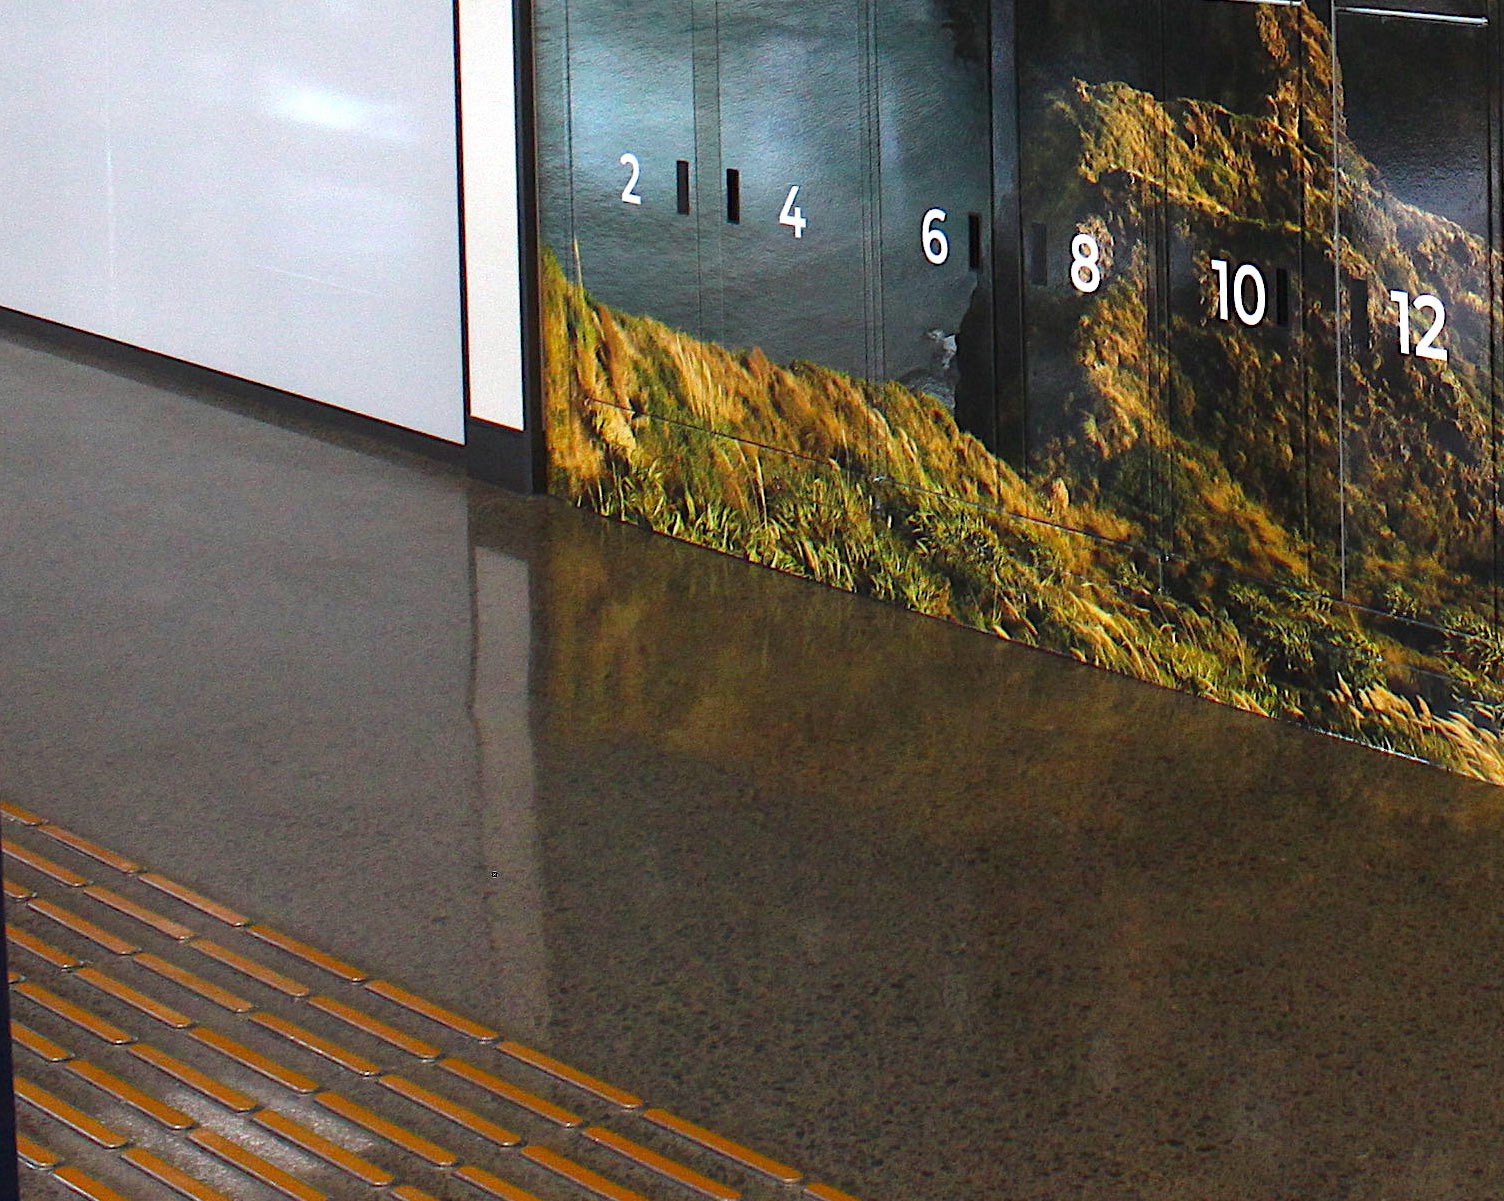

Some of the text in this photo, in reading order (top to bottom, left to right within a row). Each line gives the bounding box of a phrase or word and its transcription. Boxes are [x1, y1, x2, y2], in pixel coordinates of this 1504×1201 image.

[620, 152, 641, 205] 2
[779, 184, 807, 238] 4
[921, 207, 949, 265] 6
[1069, 232, 1102, 293] 8
[1211, 258, 1266, 326] 10
[1389, 288, 1449, 362] 12
